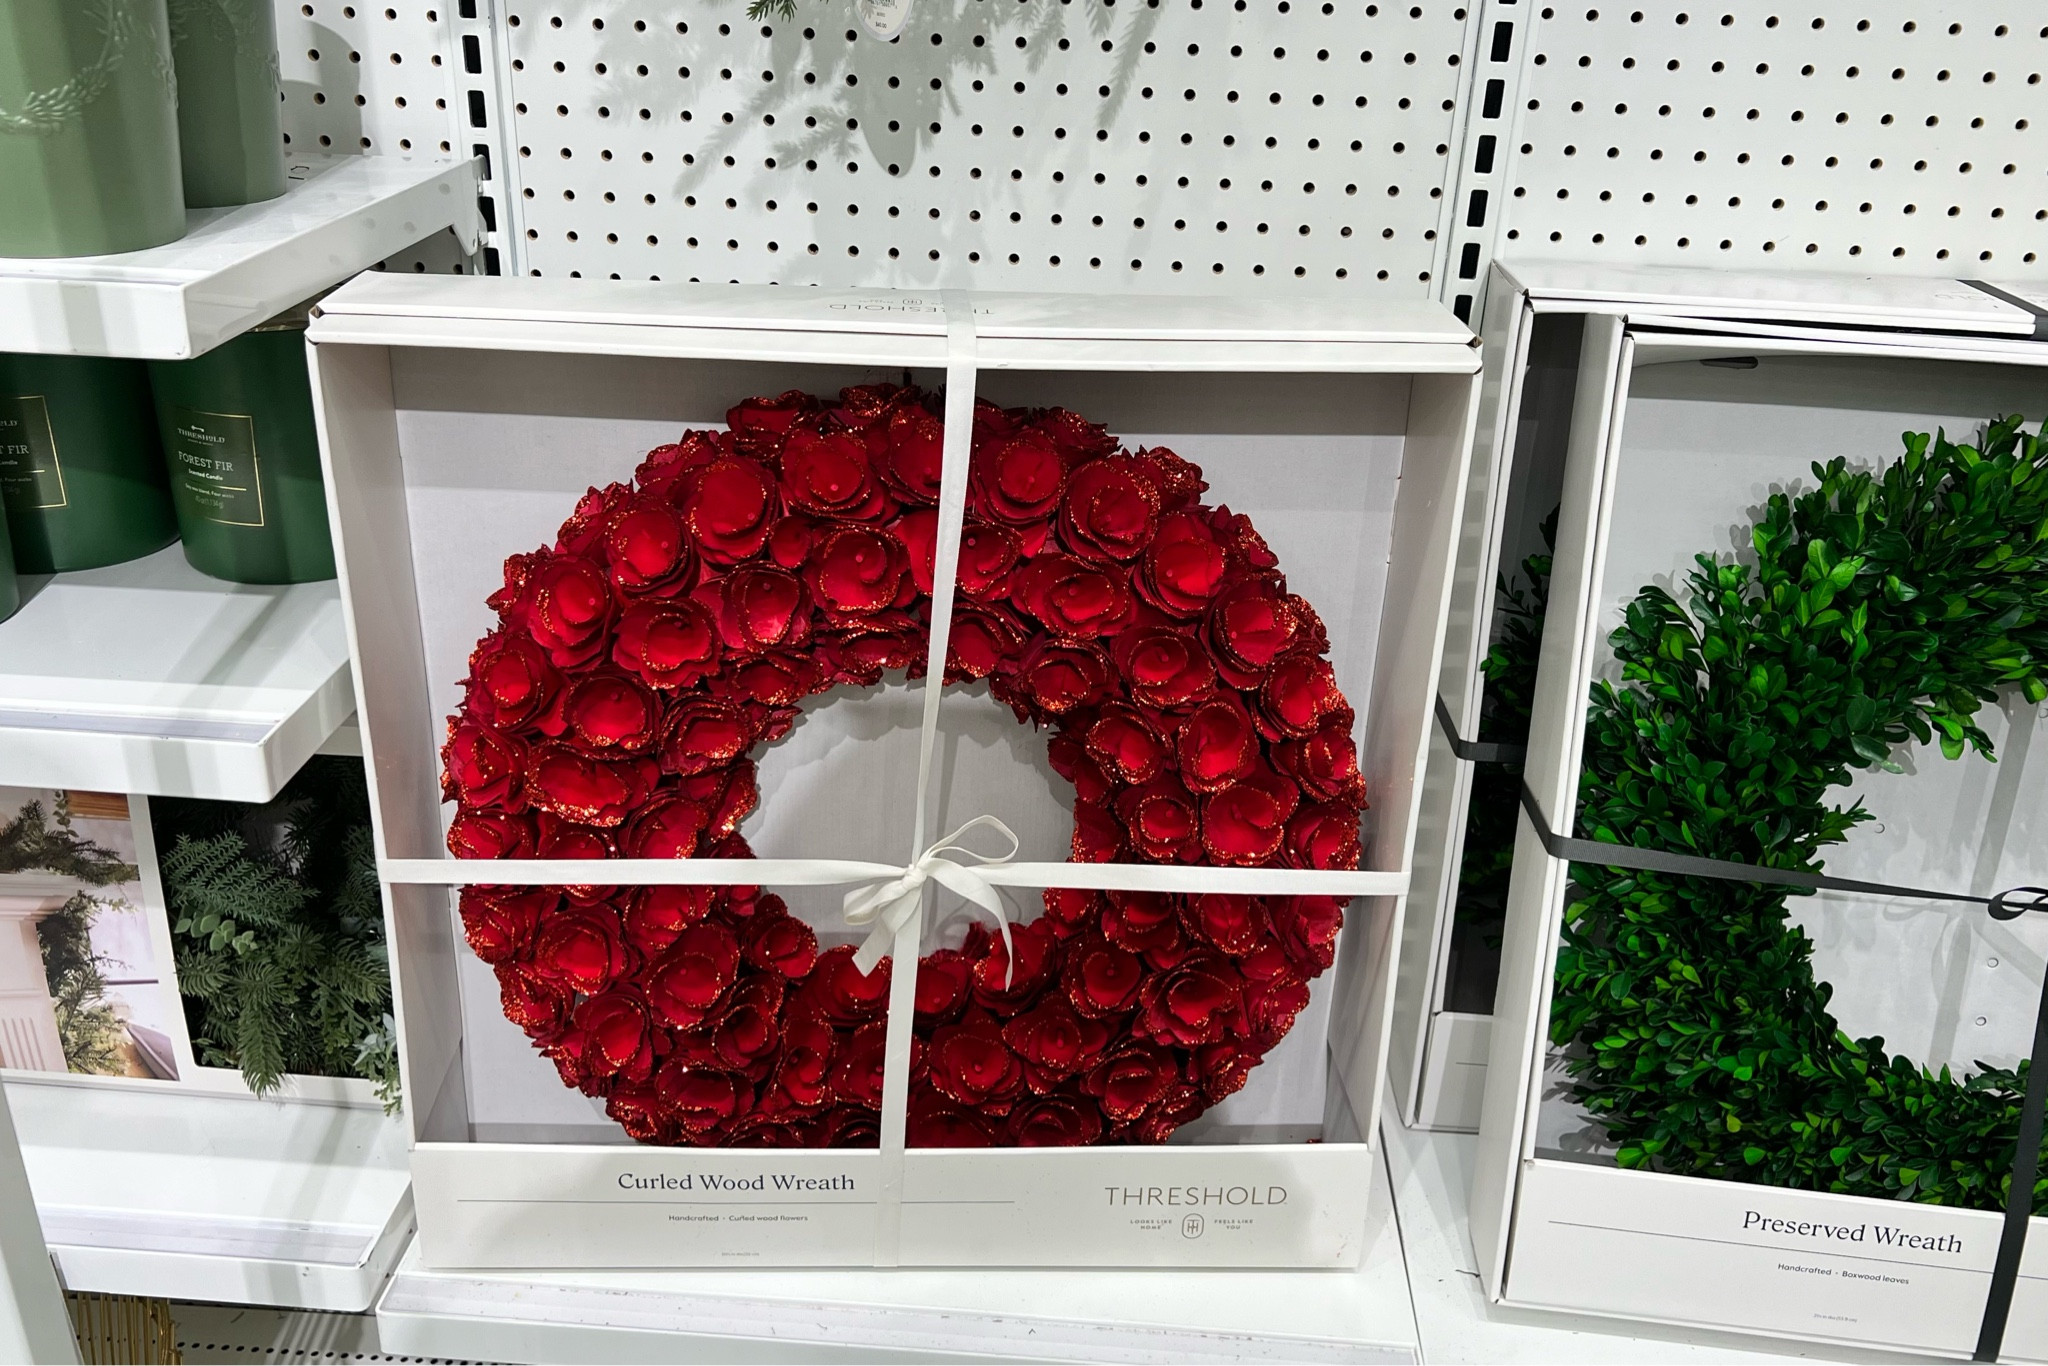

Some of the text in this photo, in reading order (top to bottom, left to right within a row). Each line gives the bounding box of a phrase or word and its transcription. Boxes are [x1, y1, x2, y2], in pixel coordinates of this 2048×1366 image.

[829, 303, 994, 315] TESHOLD
[178, 427, 226, 444] THRESHOLD
[7, 444, 30, 455] FIR
[178, 450, 235, 472] FOREST FIR
[618, 1173, 855, 1191] Curled Wood Wreath
[1104, 1186, 1288, 1206] THRESHOLD
[668, 1214, 719, 1222] Handcrafted
[780, 1214, 809, 1222] flowers
[1743, 1210, 1963, 1254] Preserved Wreath
[1777, 1263, 1910, 1286] Handcrafted Boxwood leaves
